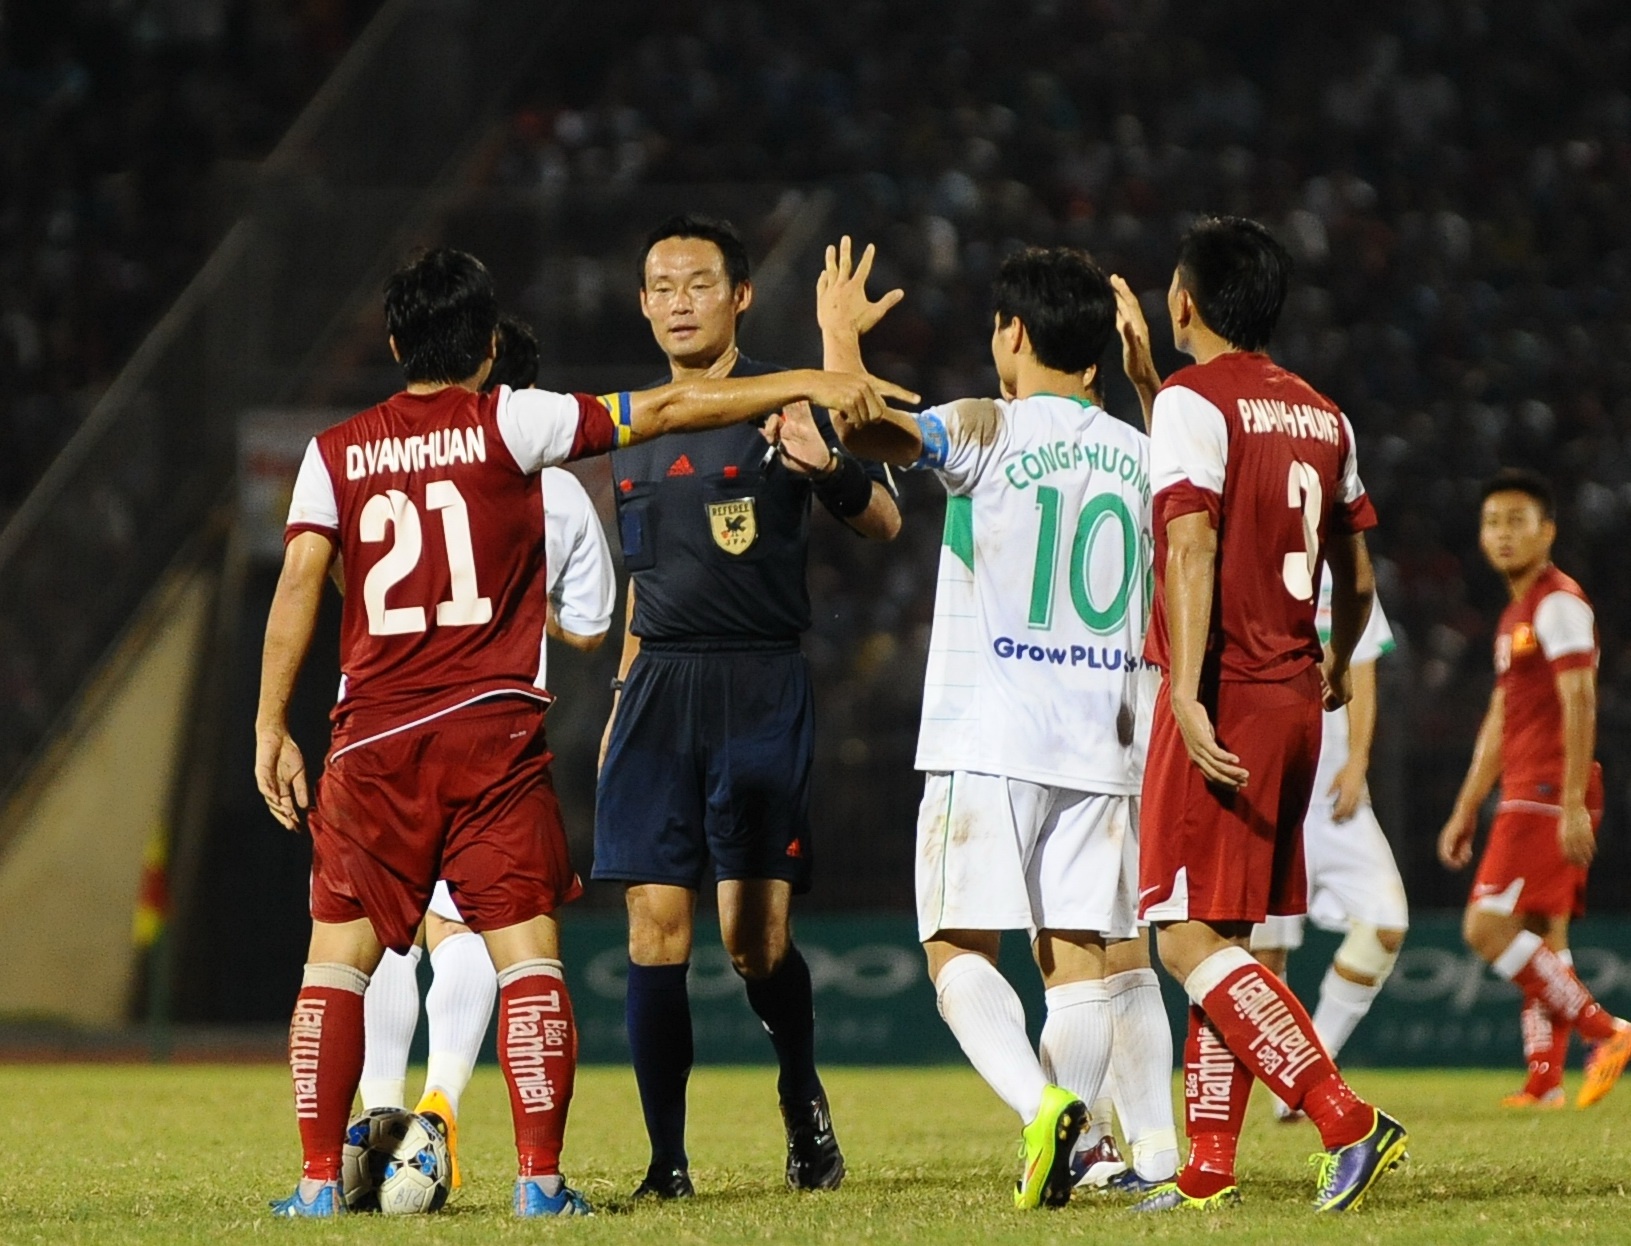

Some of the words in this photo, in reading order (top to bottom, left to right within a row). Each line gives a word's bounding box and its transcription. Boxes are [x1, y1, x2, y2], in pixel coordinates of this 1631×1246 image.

[360, 480, 493, 636] 21
[711, 503, 751, 517] REFEREE
[1028, 485, 1140, 637] 10
[1282, 460, 1323, 601] 3
